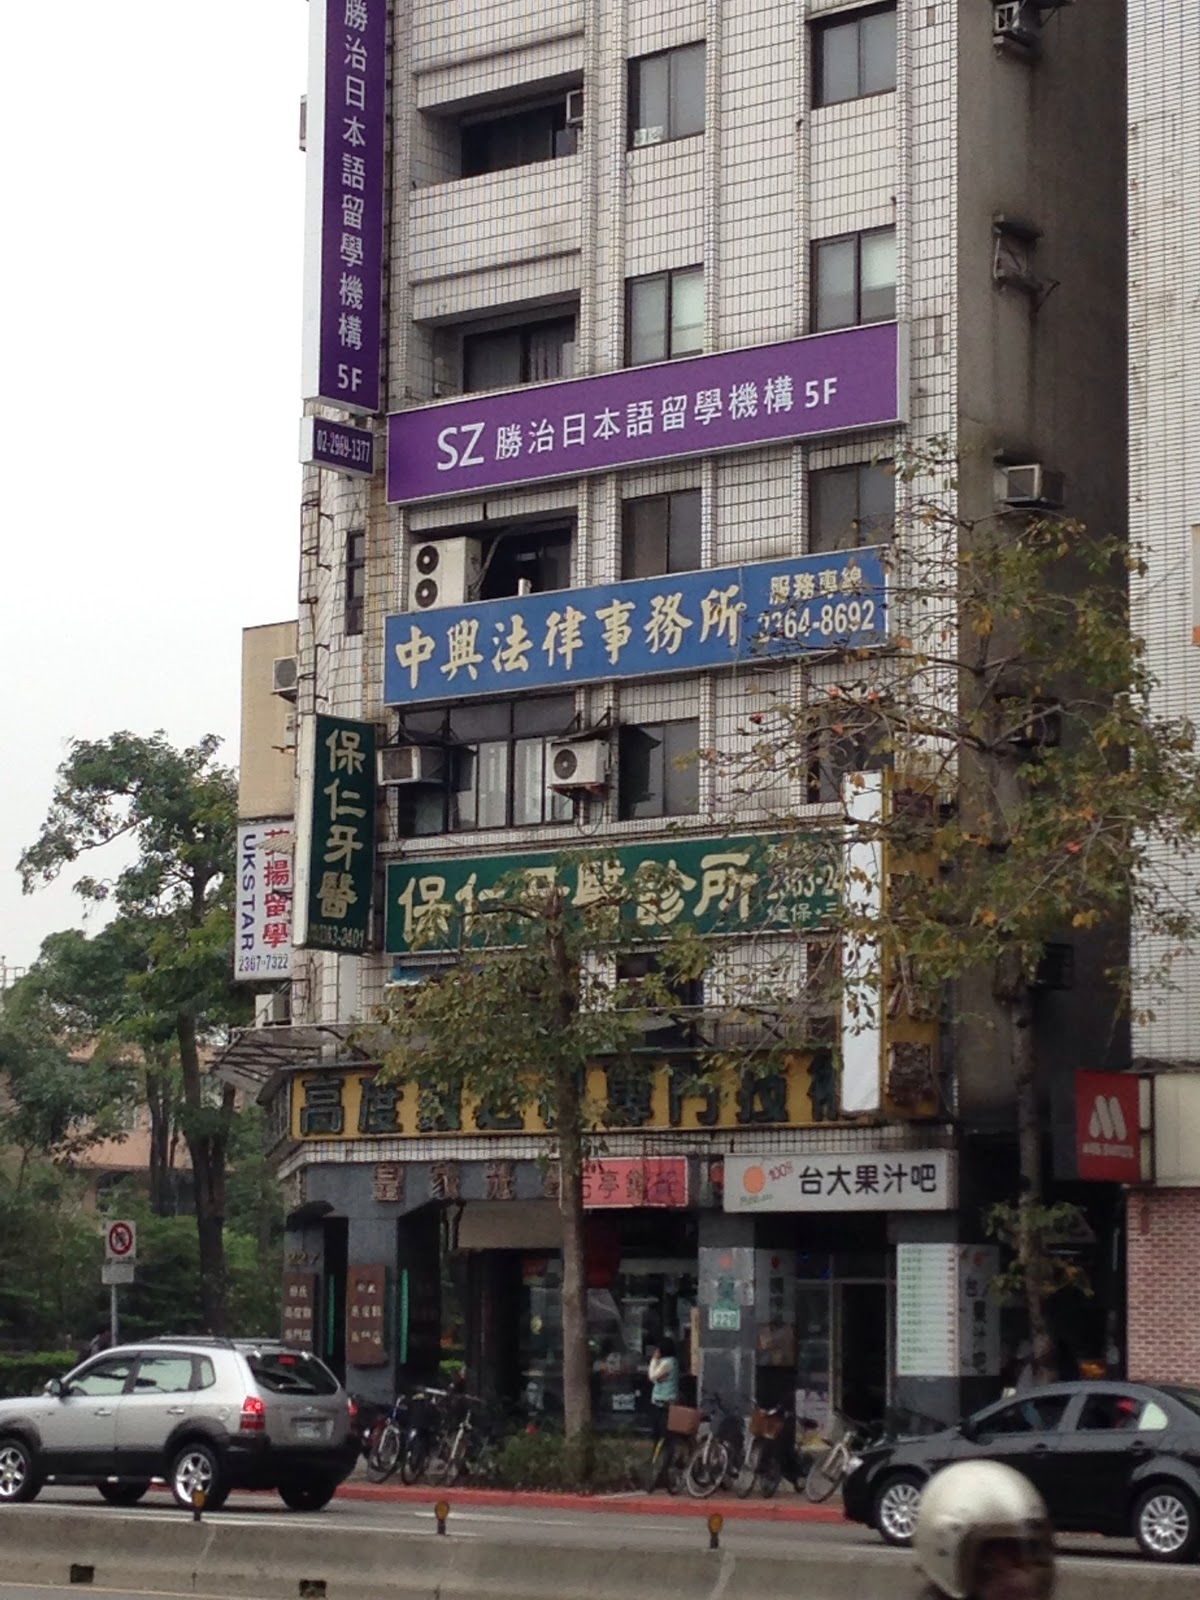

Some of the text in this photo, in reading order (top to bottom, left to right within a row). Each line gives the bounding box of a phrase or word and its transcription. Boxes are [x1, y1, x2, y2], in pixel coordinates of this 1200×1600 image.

[337, 363, 363, 393] 5F
[436, 374, 839, 473] SZ 勝治日本語留學機構 5F
[394, 584, 742, 690] 中興法律事務所
[316, 727, 367, 919] 保仁牙醫
[799, 1163, 937, 1196] 台大果汁吧
